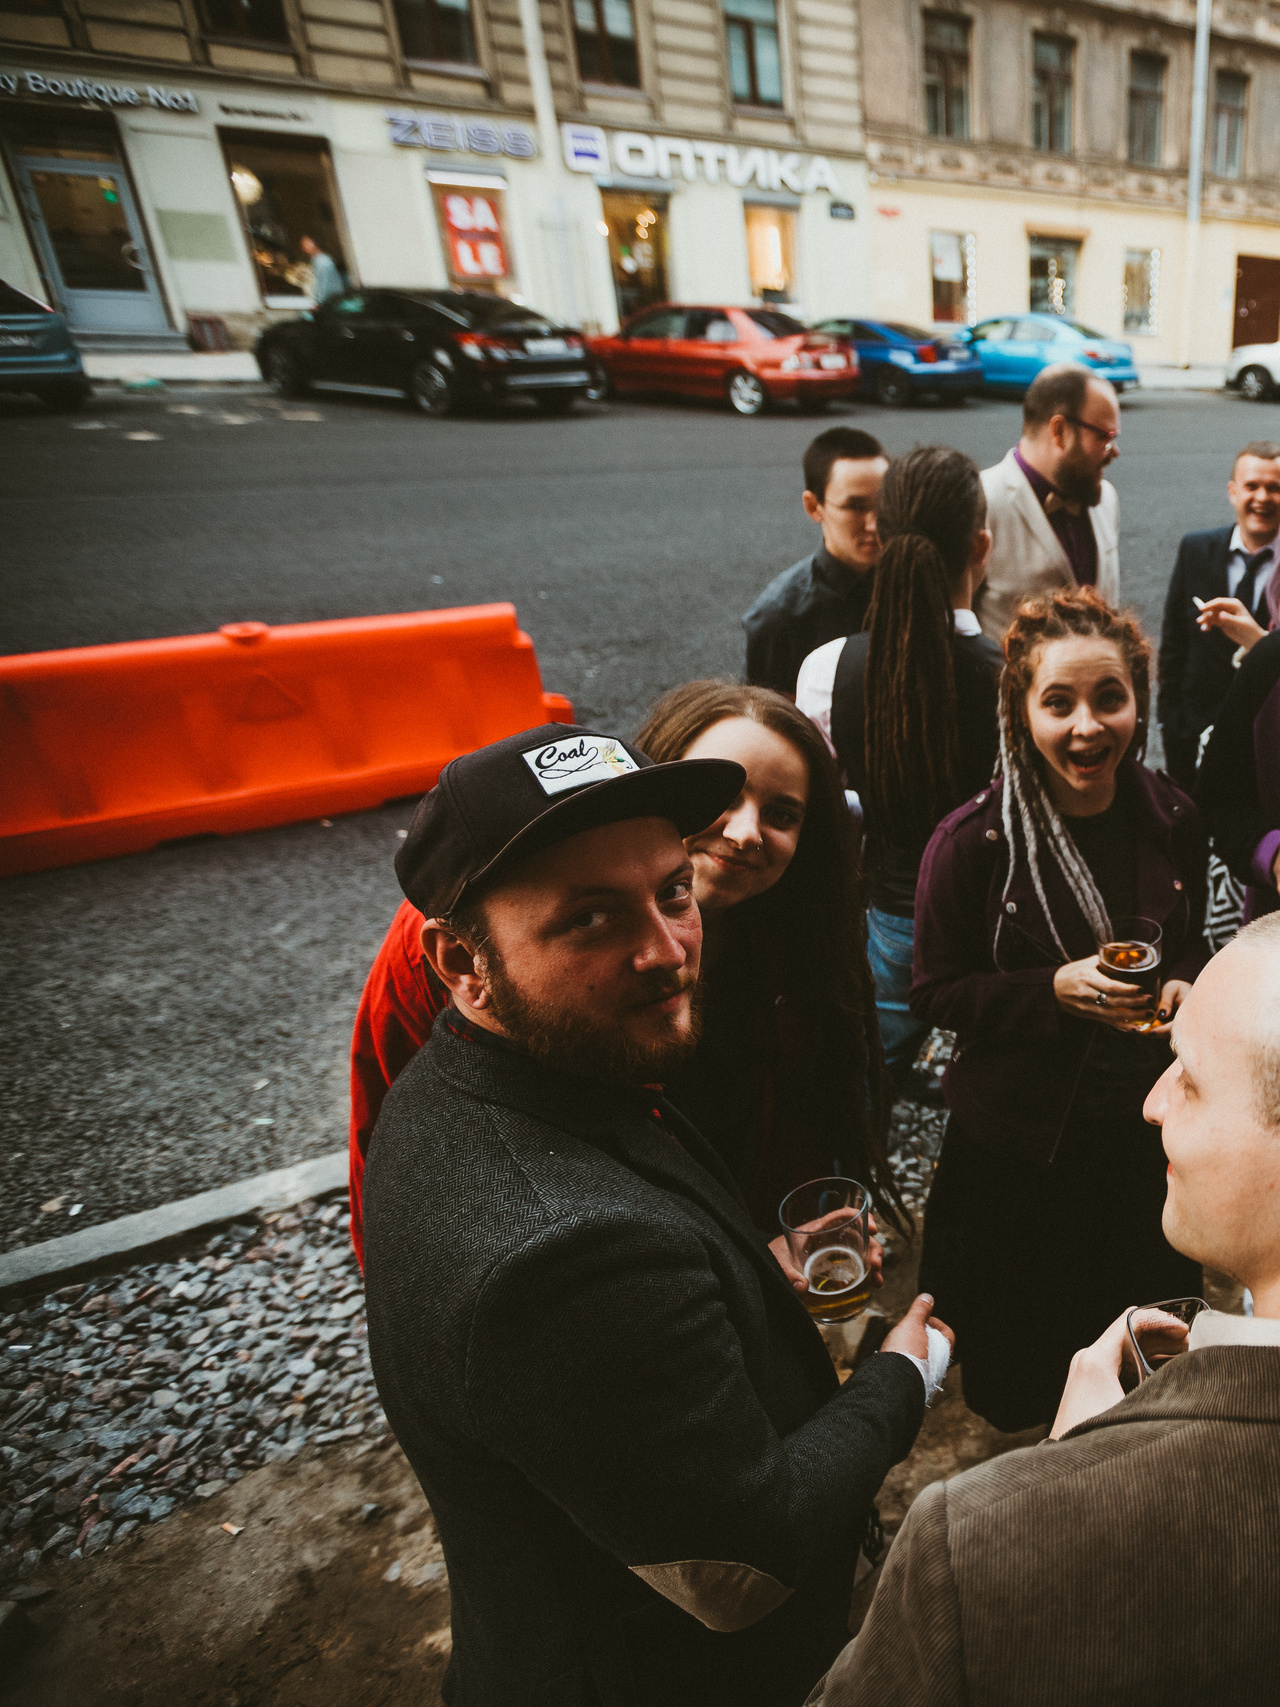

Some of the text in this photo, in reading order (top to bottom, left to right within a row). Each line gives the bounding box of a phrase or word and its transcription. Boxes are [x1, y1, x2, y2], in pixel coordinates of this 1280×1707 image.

[24, 70, 141, 106] Boutique
[385, 108, 537, 159] ZEISS
[613, 131, 839, 194] ОПТИКА
[535, 739, 588, 770] Coal
